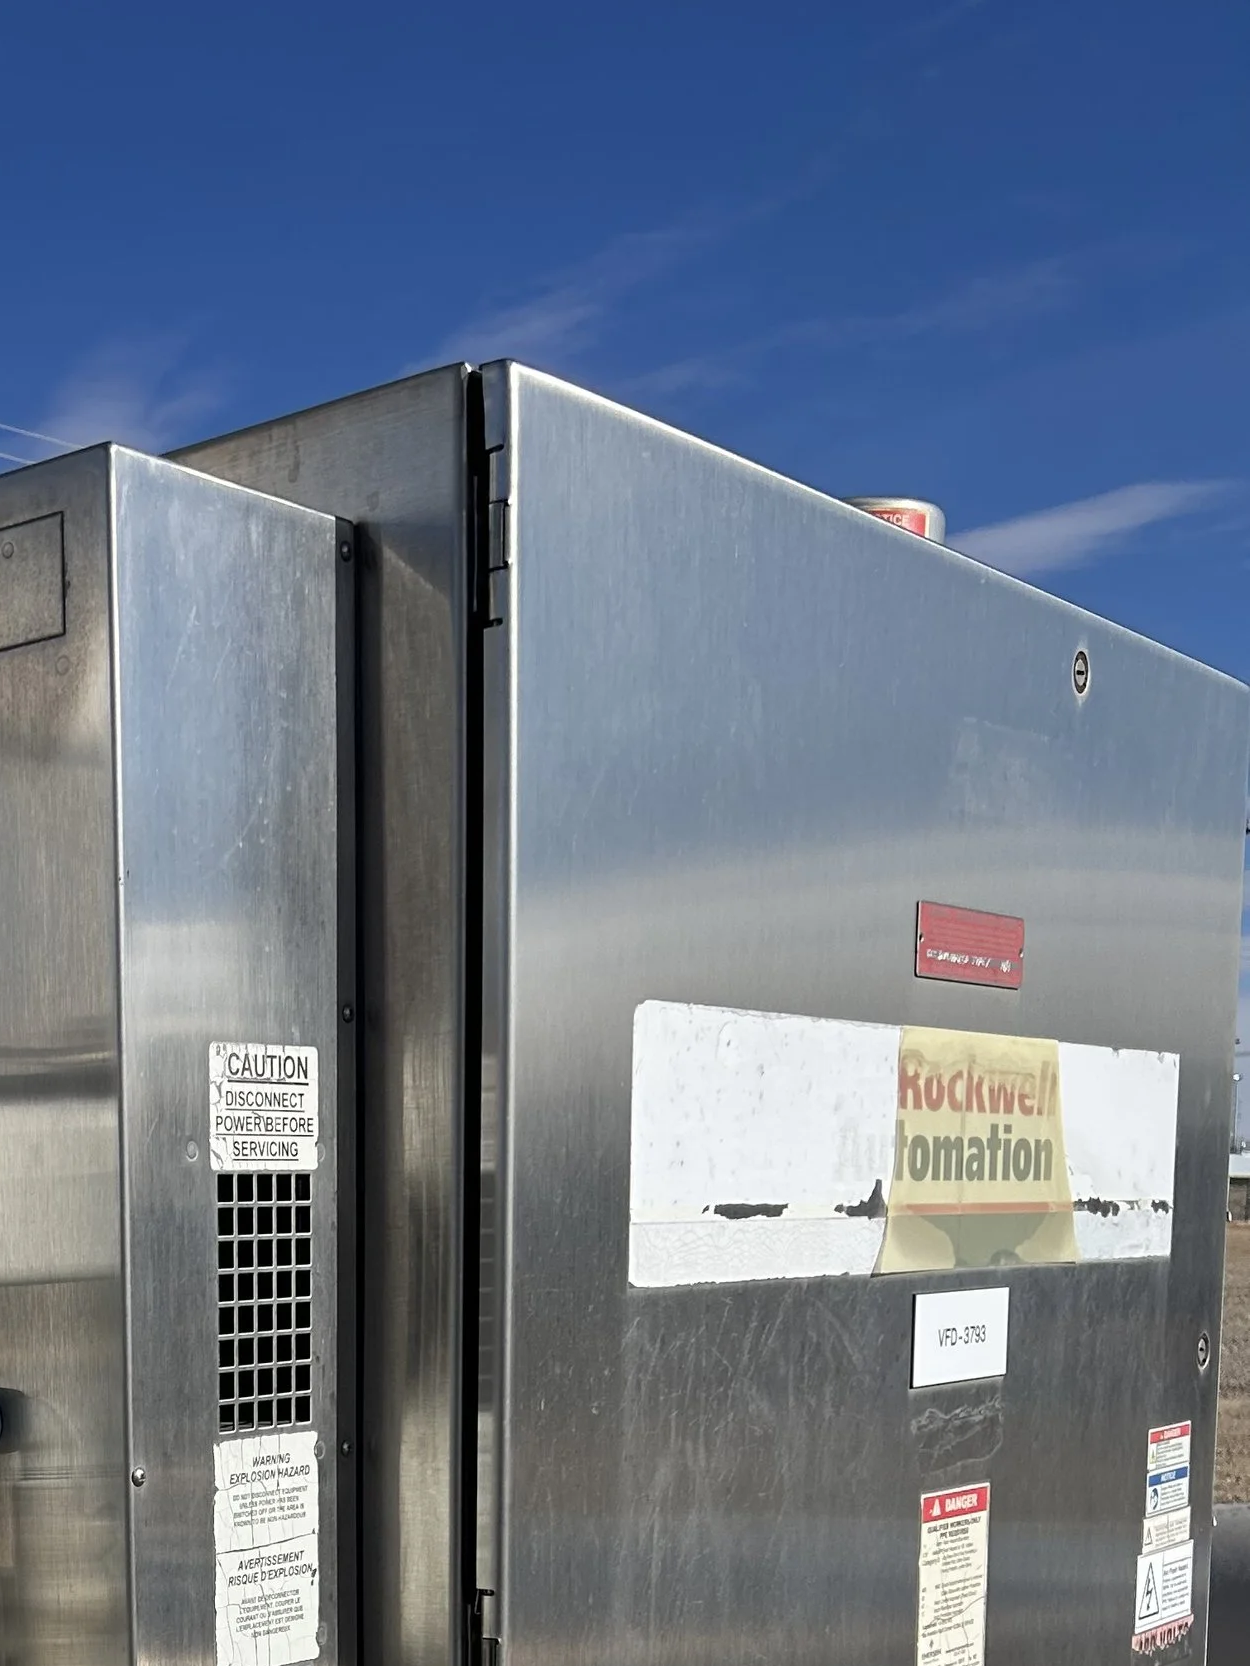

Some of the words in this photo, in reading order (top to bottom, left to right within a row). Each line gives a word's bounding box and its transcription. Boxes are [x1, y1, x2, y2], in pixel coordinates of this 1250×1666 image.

[227, 1053, 309, 1080] CAUTION
[225, 1090, 305, 1109] DISCONNECT
[216, 1115, 262, 1133] POWER
[264, 1116, 314, 1133] BEFORE
[232, 1140, 299, 1158] SERVICING
[252, 1453, 291, 1467] WARNING
[229, 1469, 276, 1485] EXPLOSION
[277, 1464, 311, 1479] HAZARD
[945, 1493, 978, 1513] DANGER
[237, 1551, 304, 1571] AVERTISSEMENT
[228, 1571, 259, 1587] RISQUE
[260, 1563, 313, 1582] D'EXPLOSION
